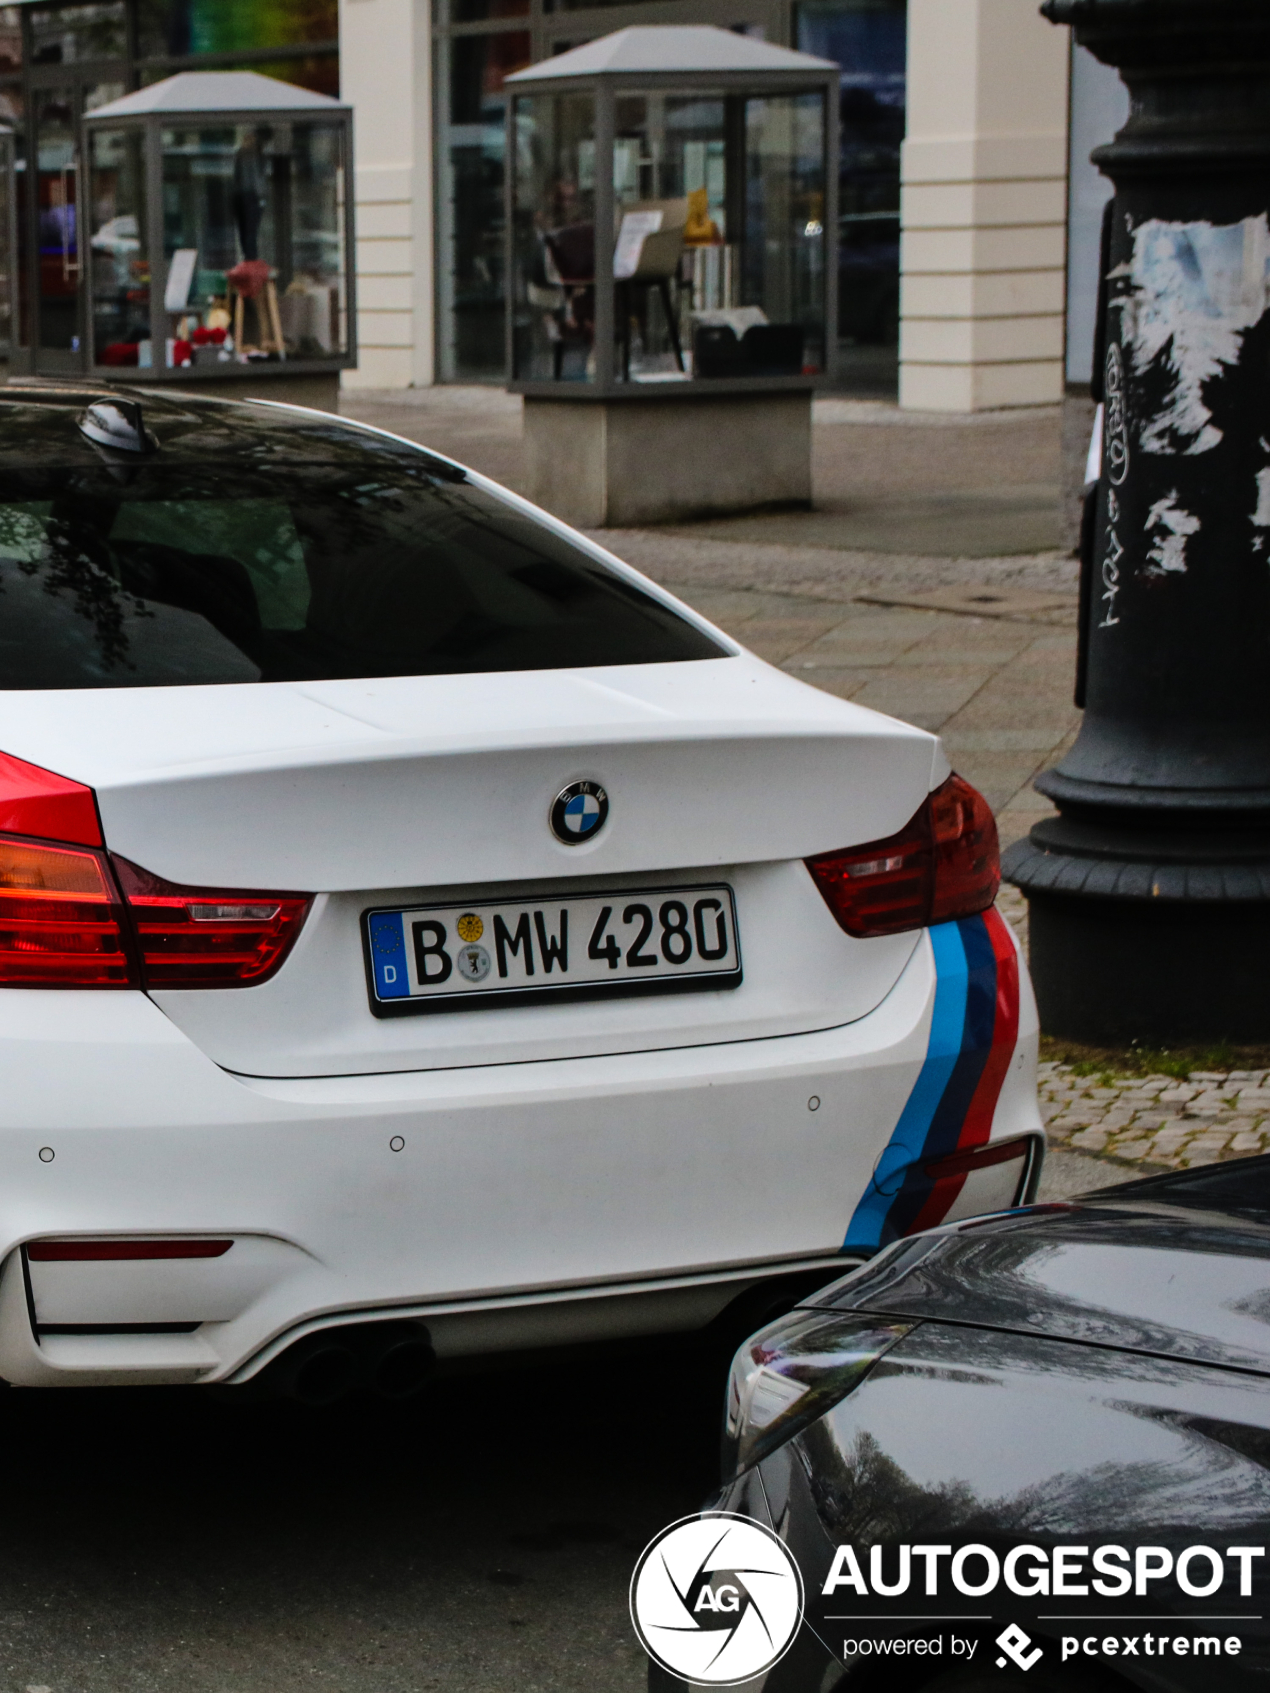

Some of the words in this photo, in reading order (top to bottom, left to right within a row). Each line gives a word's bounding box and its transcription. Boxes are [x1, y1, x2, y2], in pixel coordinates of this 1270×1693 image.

[559, 782, 607, 803] BMW
[411, 920, 453, 986] B
[493, 909, 568, 978] MW
[587, 898, 729, 969] 4280
[383, 965, 397, 984] D
